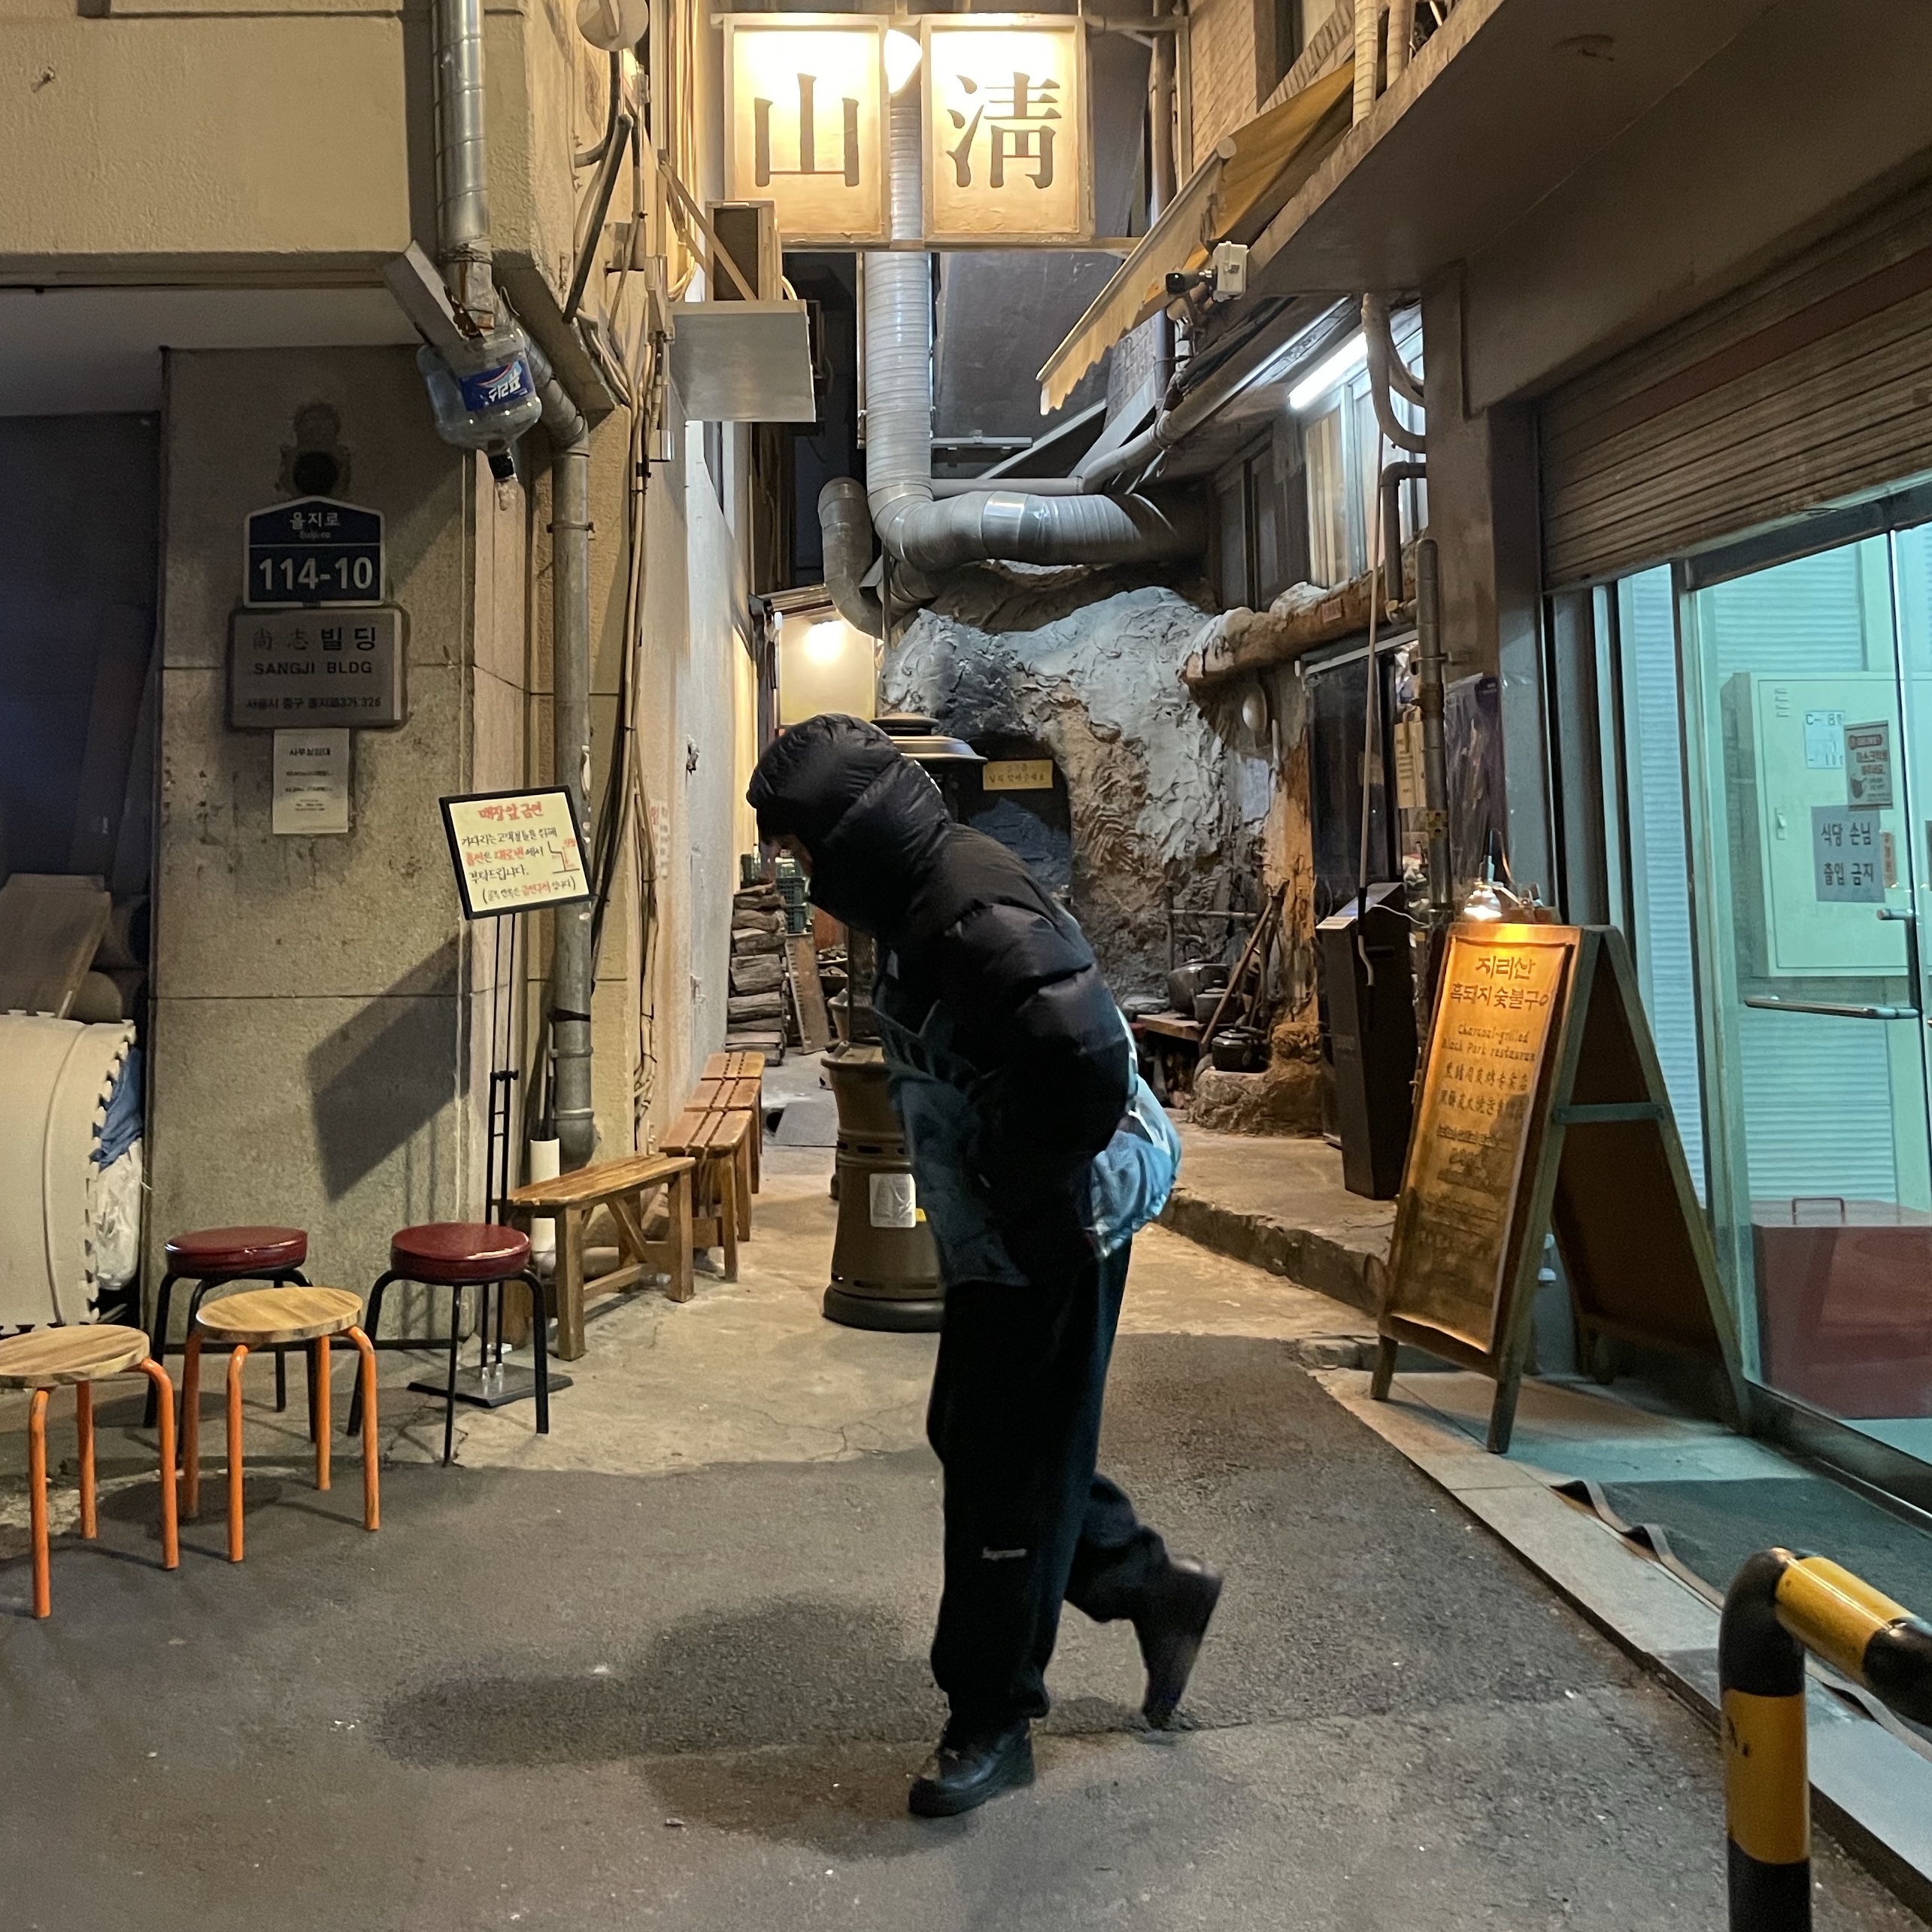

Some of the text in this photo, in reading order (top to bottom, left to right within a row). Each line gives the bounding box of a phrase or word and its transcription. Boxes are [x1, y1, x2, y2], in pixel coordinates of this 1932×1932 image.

[754, 72, 860, 188] 山
[290, 511, 341, 530] 을지로
[259, 556, 374, 591] 114-10
[253, 661, 372, 675] SANGJI BLDG
[461, 833, 498, 848] 기다리는
[1821, 822, 1872, 847] 식당 손님
[1824, 863, 1874, 886] 출입 금지
[1475, 955, 1536, 981] 지리산
